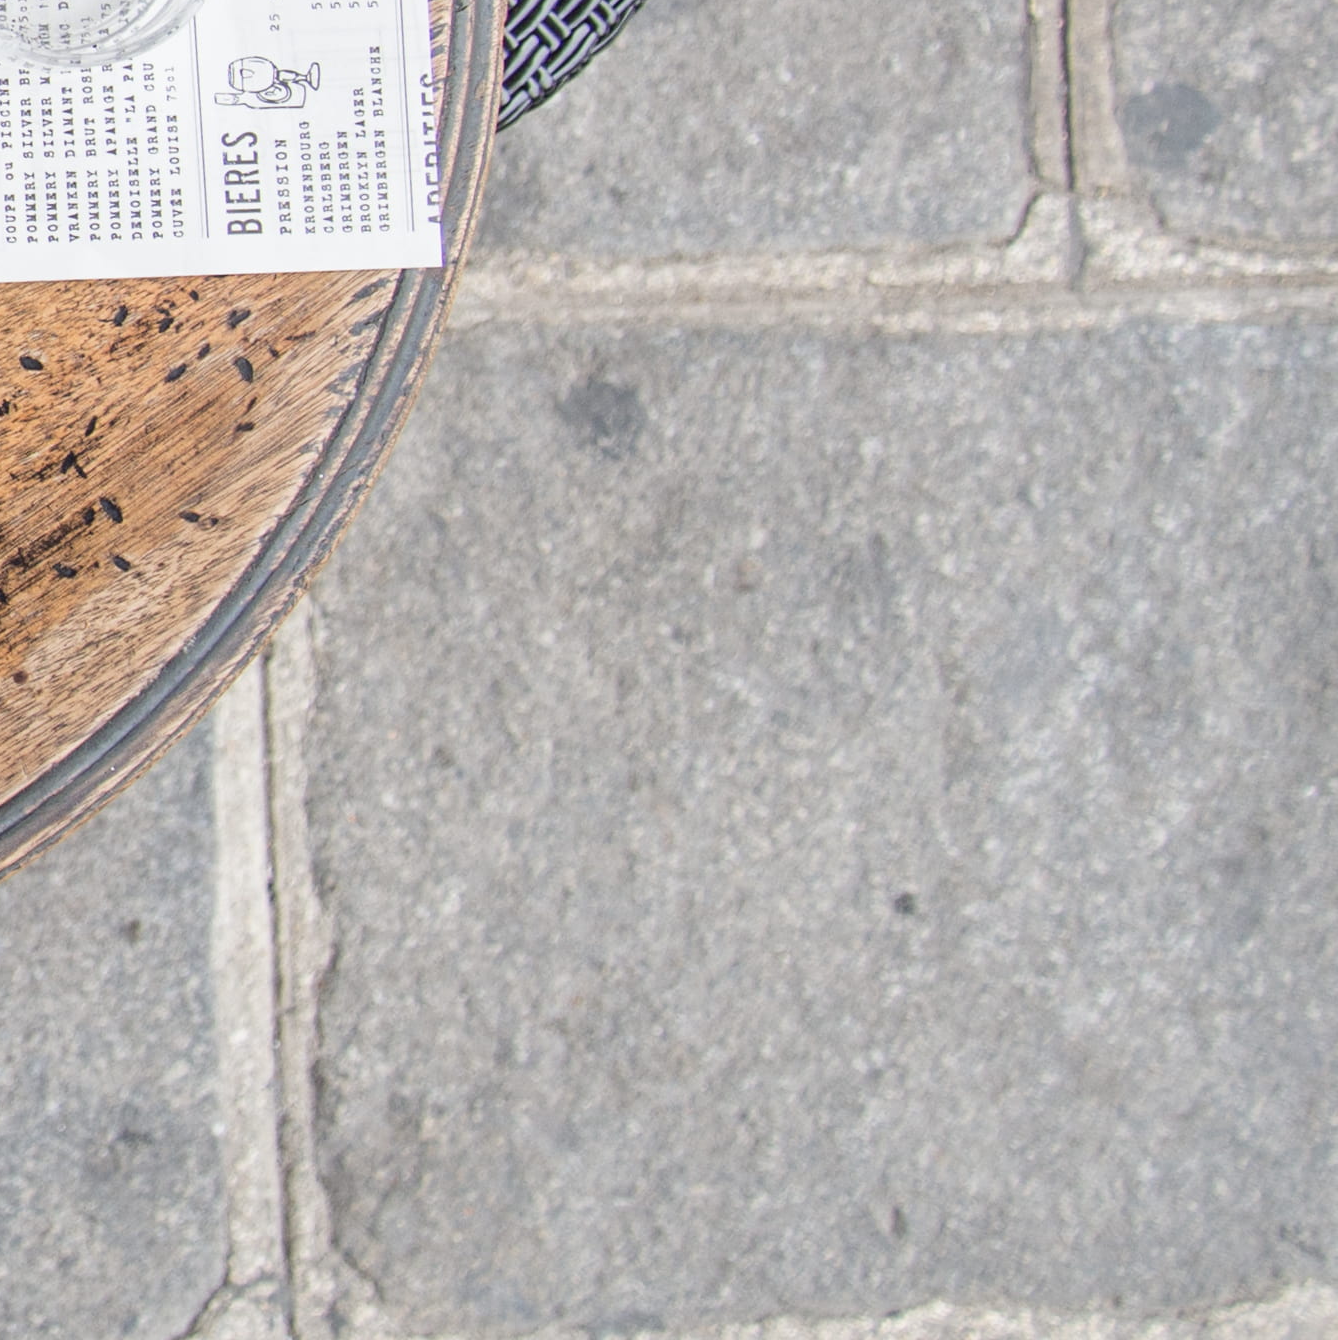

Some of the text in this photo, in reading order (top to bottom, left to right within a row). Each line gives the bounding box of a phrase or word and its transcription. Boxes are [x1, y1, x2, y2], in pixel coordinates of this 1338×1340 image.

[269, 13, 281, 32] 25
[123, 94, 137, 123] "LA
[143, 62, 157, 92] CRU
[353, 86, 367, 138] LAGER
[369, 44, 385, 116] BLANCHE
[20, 97, 35, 159] SILVER
[41, 96, 55, 158] SILVER
[61, 86, 76, 158] DIAMANT
[83, 116, 97, 157] BRUT
[103, 84, 119, 156] APANAGE
[145, 104, 159, 154] GRAND
[166, 114, 181, 175] LOUISE
[3, 161, 14, 180] ou
[43, 171, 59, 242] POMMERY
[65, 170, 81, 242] VRANKEN
[86, 170, 101, 242] POMMERY
[107, 168, 123, 240] POMMERY
[127, 136, 143, 240] DEMOISELLE
[149, 167, 163, 239] POMMERY
[221, 131, 263, 235] BIERES
[275, 138, 292, 235] PRESSION
[299, 120, 317, 234] KRONENBOURG
[319, 141, 335, 233] CARLSBERG
[337, 130, 353, 233] GRIMBERGEN
[357, 150, 373, 232] BROOKLYN
[374, 128, 391, 232] GRIMBERGEN
[4, 192, 17, 244] COUPE
[23, 172, 39, 243] POMMERY
